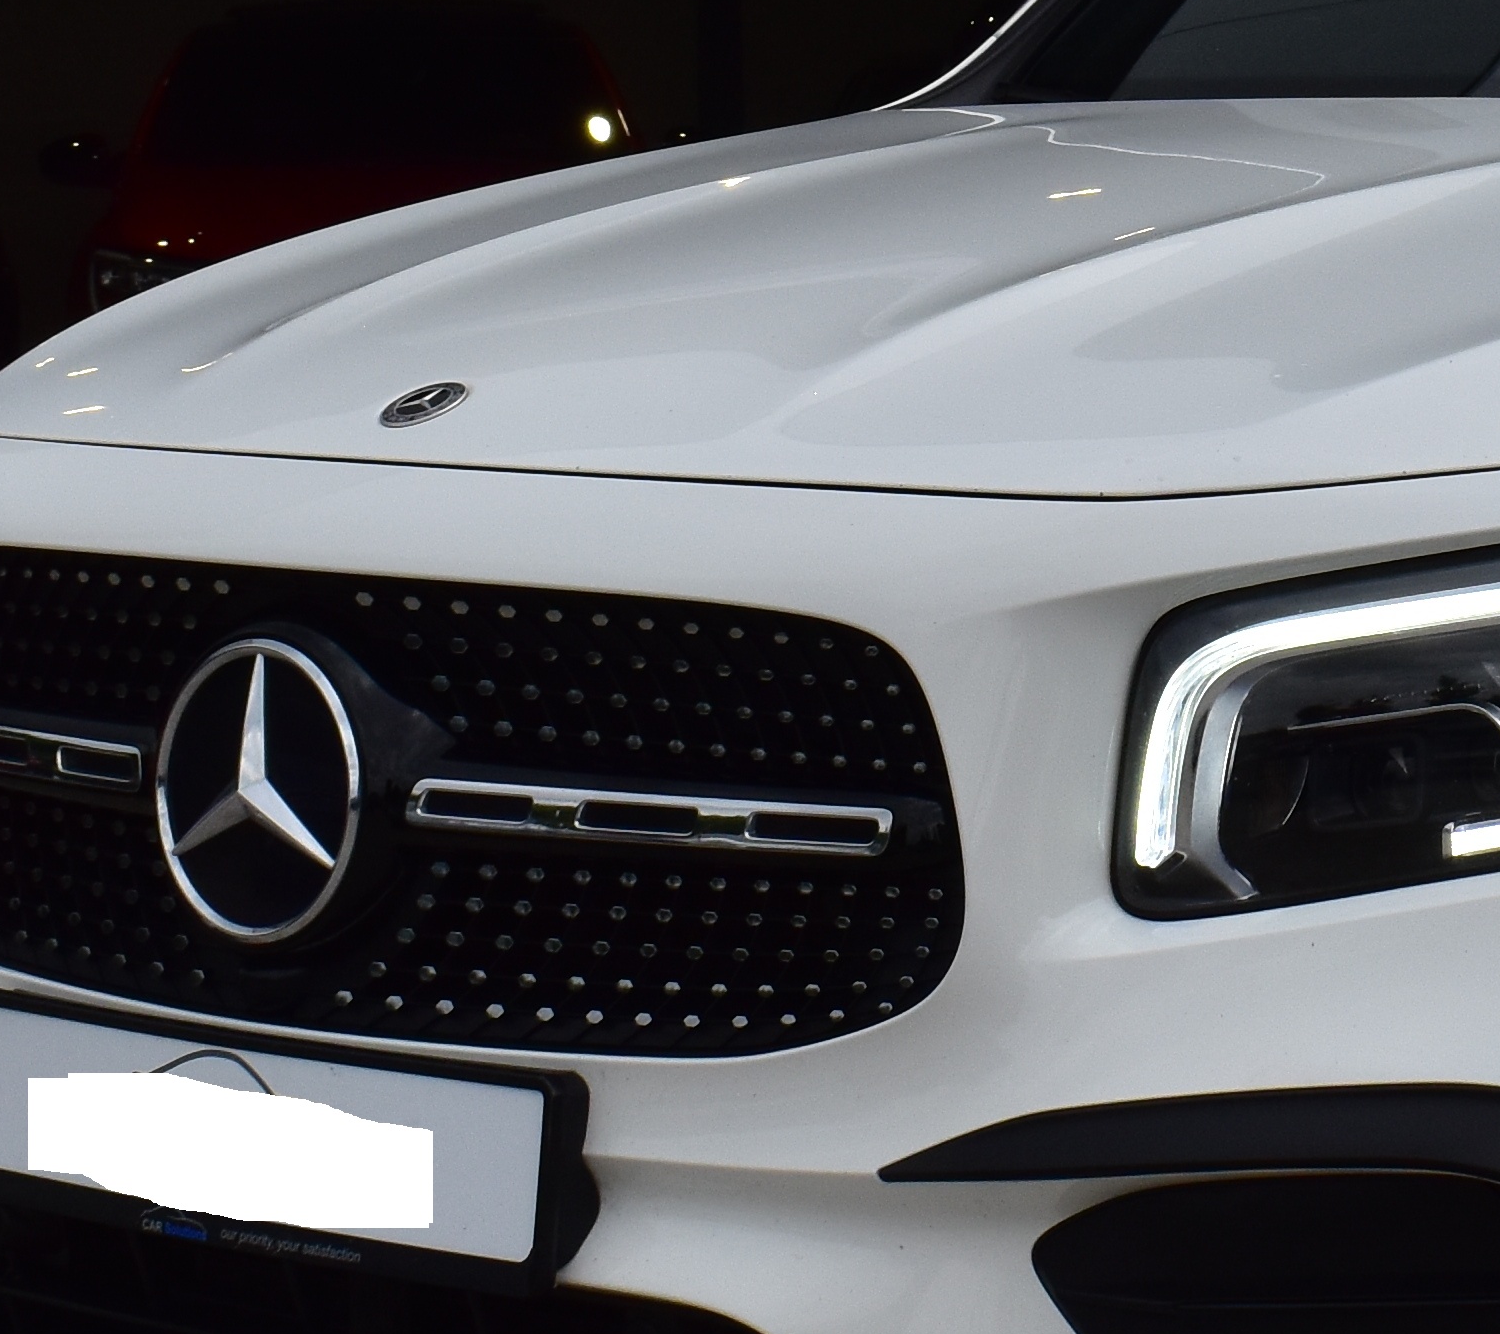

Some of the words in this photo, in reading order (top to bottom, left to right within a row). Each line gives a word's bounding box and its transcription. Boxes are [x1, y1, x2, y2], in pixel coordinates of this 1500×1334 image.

[141, 1219, 163, 1233] CAR
[164, 1223, 208, 1241] Solutions
[220, 1229, 238, 1241] our
[274, 1238, 301, 1253] your
[301, 1242, 362, 1263] satisfaction
